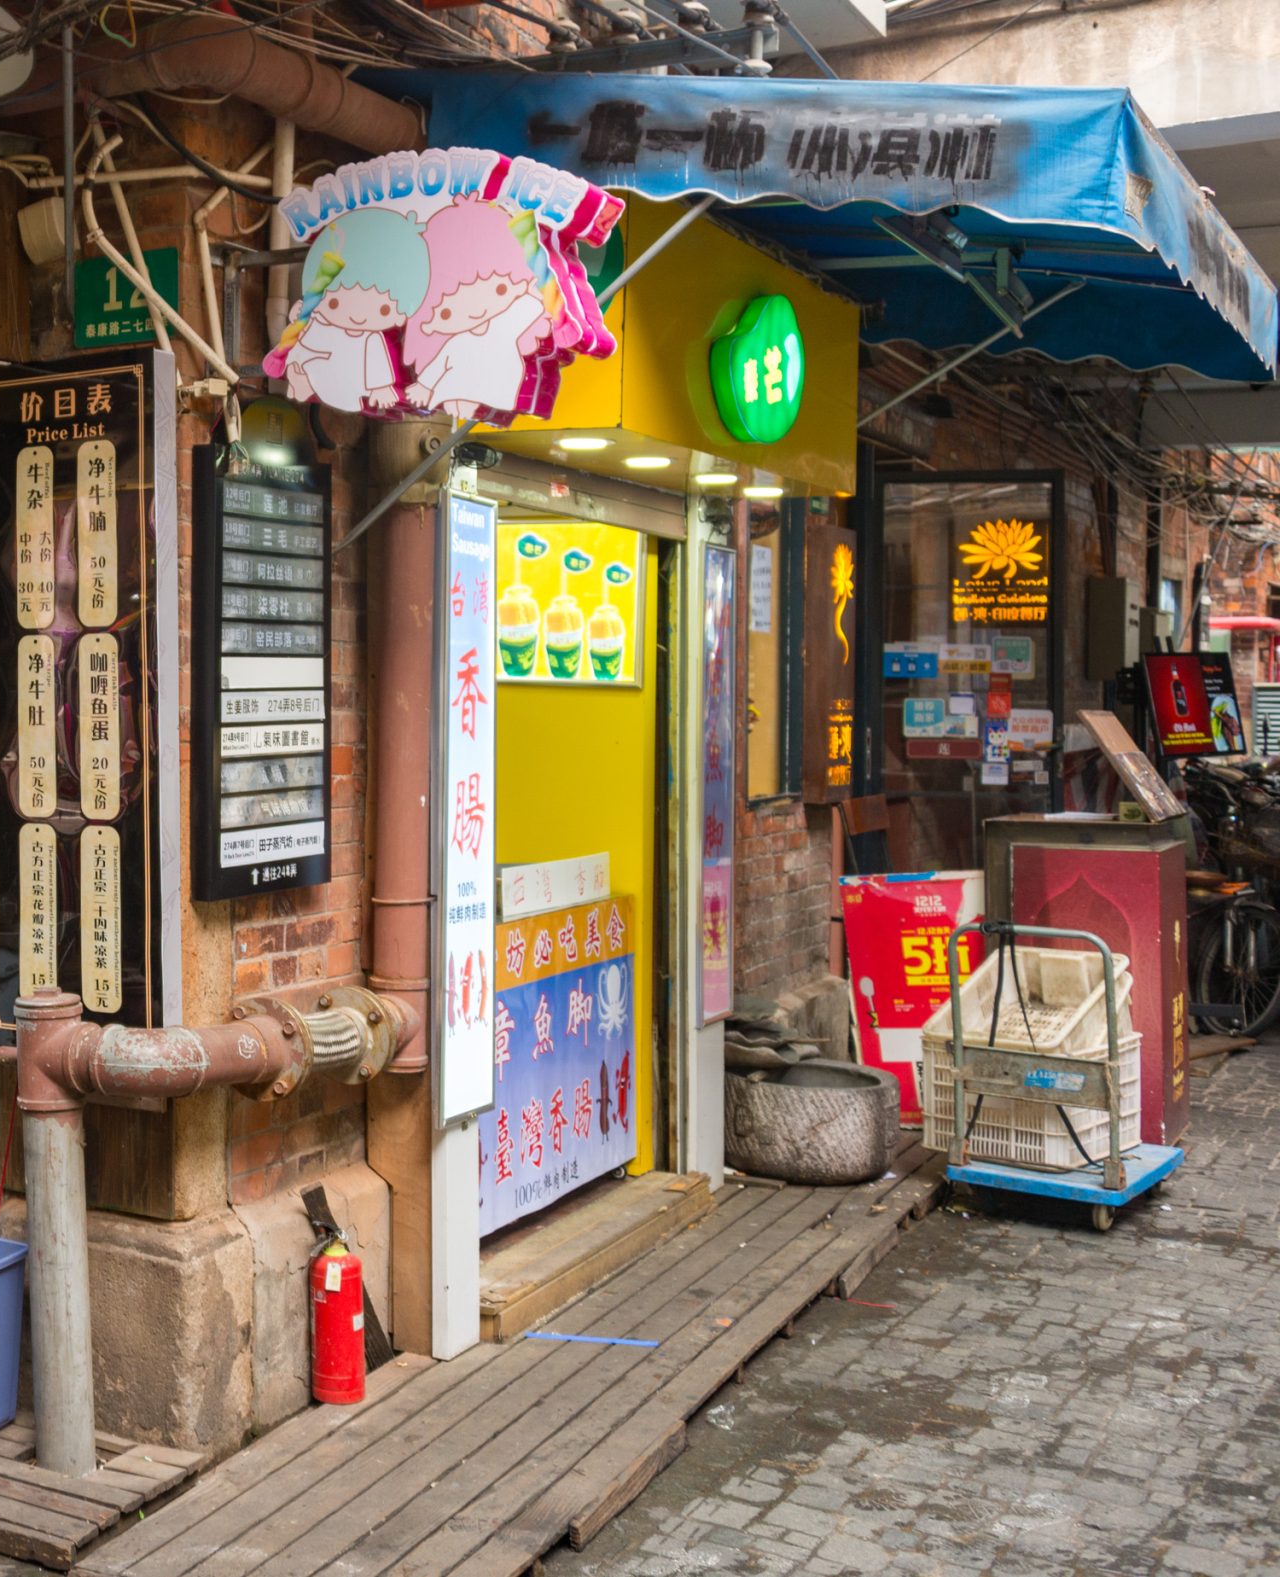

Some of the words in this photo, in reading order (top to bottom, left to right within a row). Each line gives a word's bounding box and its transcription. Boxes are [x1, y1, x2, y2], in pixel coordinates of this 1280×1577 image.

[286, 153, 493, 236] RAINBOW
[510, 161, 588, 223] ICE
[86, 317, 169, 337] 泰康路二七四
[21, 383, 112, 423] 价目表
[27, 427, 69, 444] Price
[72, 422, 105, 440] List
[27, 463, 44, 511] 牛杂
[88, 457, 107, 532] 净牛腩
[452, 501, 485, 529] Taiwan
[20, 531, 32, 564] 中份
[39, 530, 52, 563] 大份
[19, 581, 34, 612] 30元
[37, 580, 53, 612] 40元
[28, 653, 45, 727] 净牛肚
[90, 652, 109, 741] 咖喱鱼蛋
[267, 697, 321, 713] 274弄8号后门
[31, 841, 45, 955] 古方正宗花瓣凉茶
[94, 844, 108, 970] 古方正宗二十四味凉茶
[496, 904, 625, 978] 坊必吃美食
